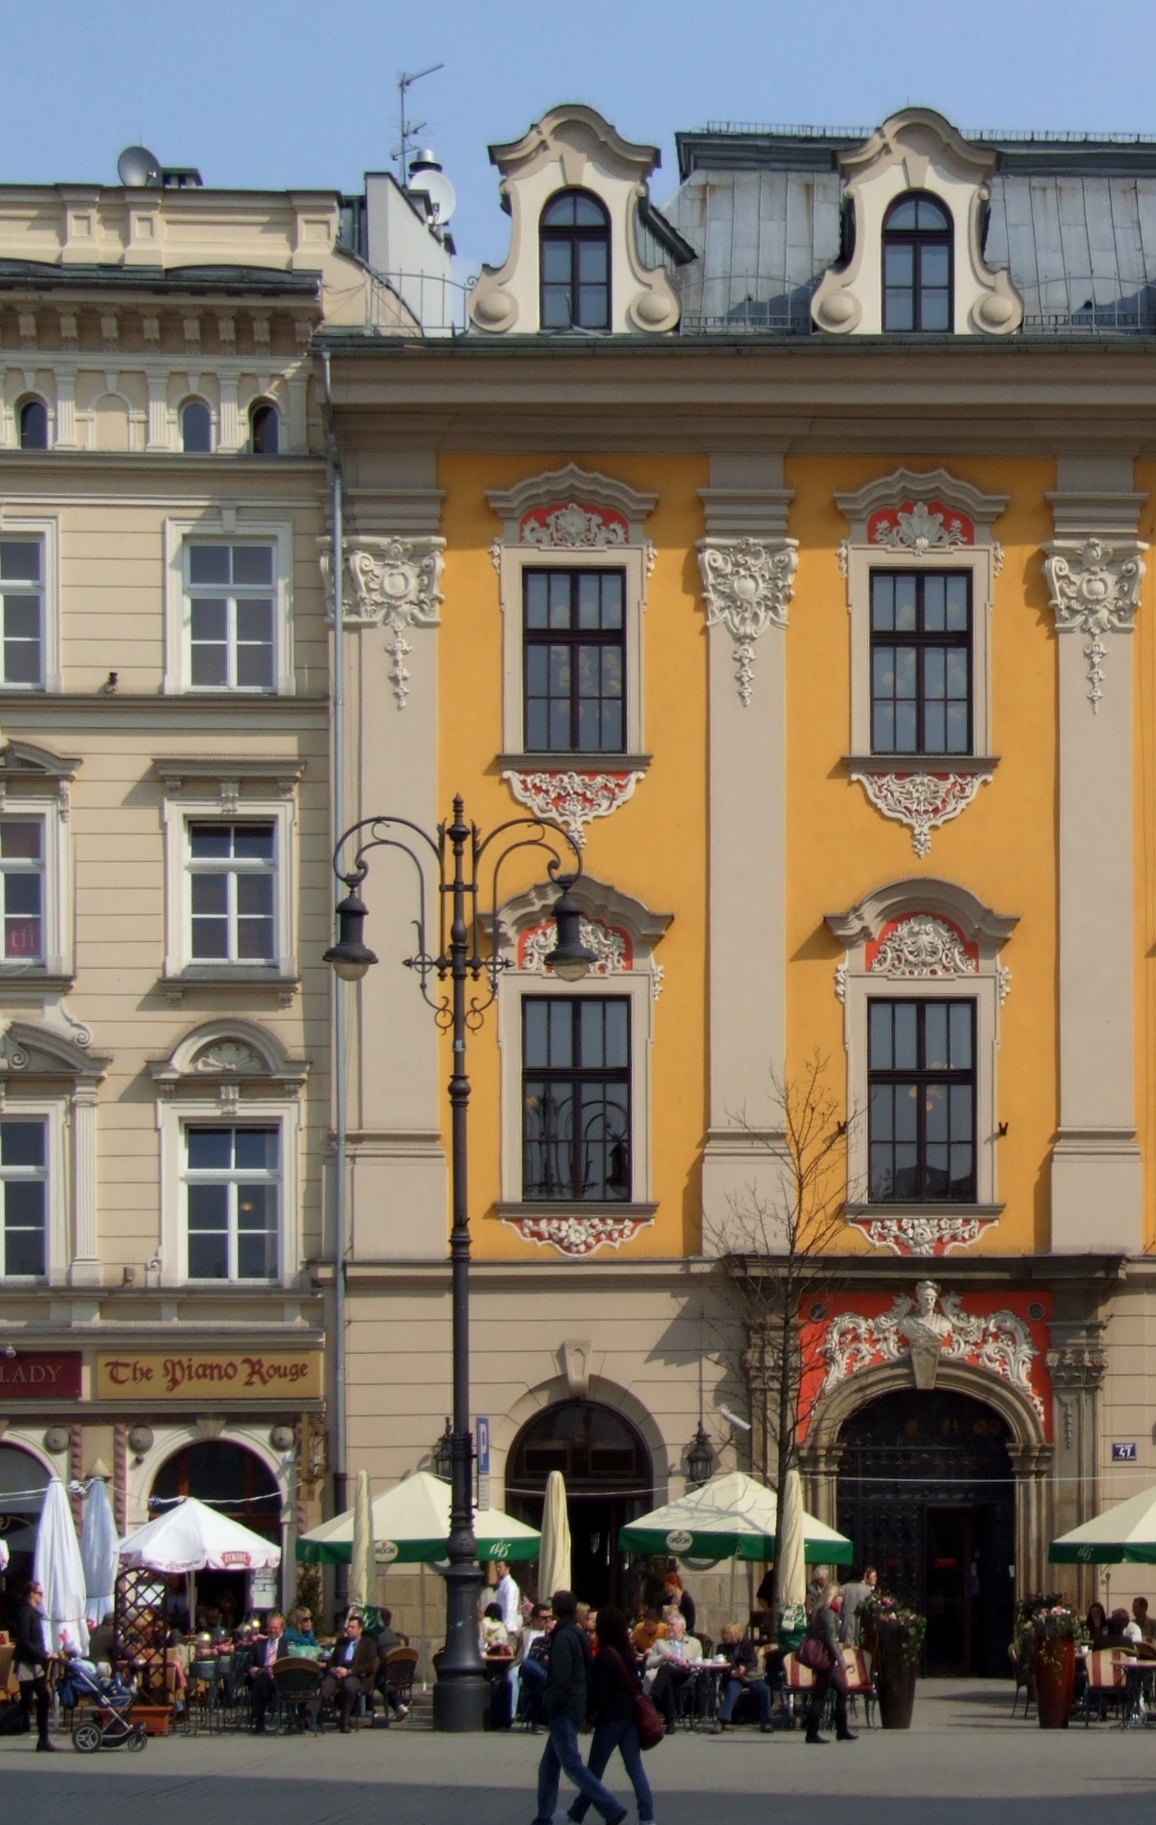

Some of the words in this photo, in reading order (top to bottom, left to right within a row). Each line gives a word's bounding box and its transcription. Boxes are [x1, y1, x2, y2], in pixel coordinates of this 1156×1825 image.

[0, 1365, 62, 1384] LADY
[104, 1359, 154, 1385] The
[162, 1357, 238, 1393] Piano
[242, 1357, 309, 1386] Rouge
